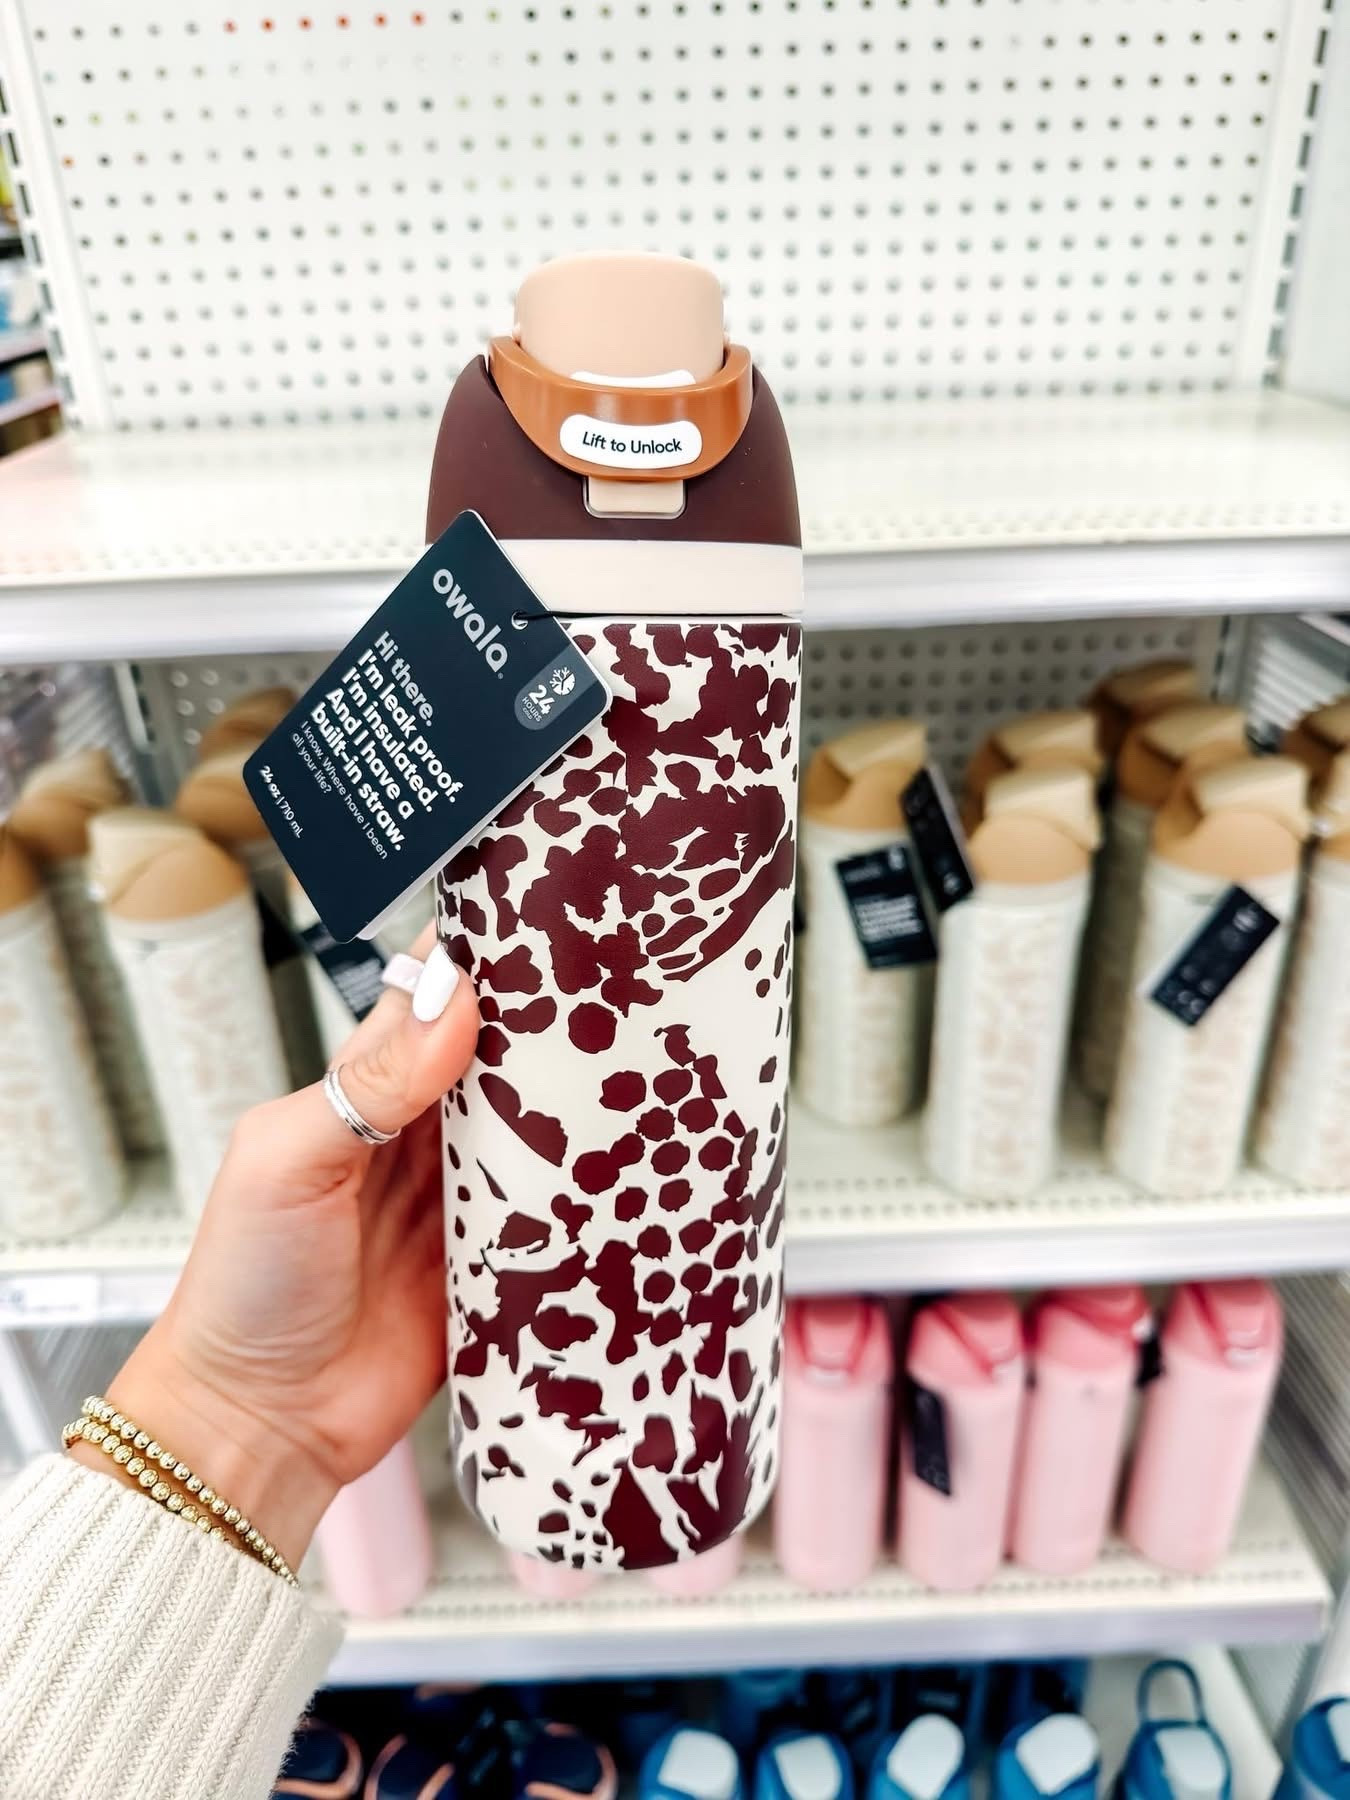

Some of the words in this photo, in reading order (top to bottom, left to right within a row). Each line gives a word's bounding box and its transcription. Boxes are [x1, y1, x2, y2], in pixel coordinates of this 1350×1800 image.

[582, 431, 606, 450] Lift
[610, 439, 626, 452] to
[631, 438, 682, 454] Unlock
[374, 631, 398, 662] Hi
[391, 658, 433, 726] there.
[325, 688, 362, 736] And
[522, 696, 542, 722] HOURS
[528, 684, 555, 715] 24
[301, 720, 309, 729] I
[342, 667, 368, 708] I'm
[362, 701, 439, 812] insulated.
[353, 729, 369, 746] I
[357, 649, 384, 690] I'm
[379, 683, 417, 739] leak
[408, 735, 464, 803] proof.
[303, 729, 324, 760] know.
[292, 733, 304, 748] all
[298, 747, 317, 772] your
[314, 770, 332, 793] life?
[310, 702, 362, 785] built-in
[358, 783, 405, 851] straw.
[322, 756, 346, 795] Where
[360, 740, 401, 800] have
[260, 765, 274, 783] 24
[269, 783, 281, 798] oz
[280, 803, 295, 821] 710
[290, 821, 304, 838] mL
[344, 794, 365, 824] have
[398, 800, 415, 820] a
[362, 822, 370, 830] I
[366, 827, 388, 860] been
